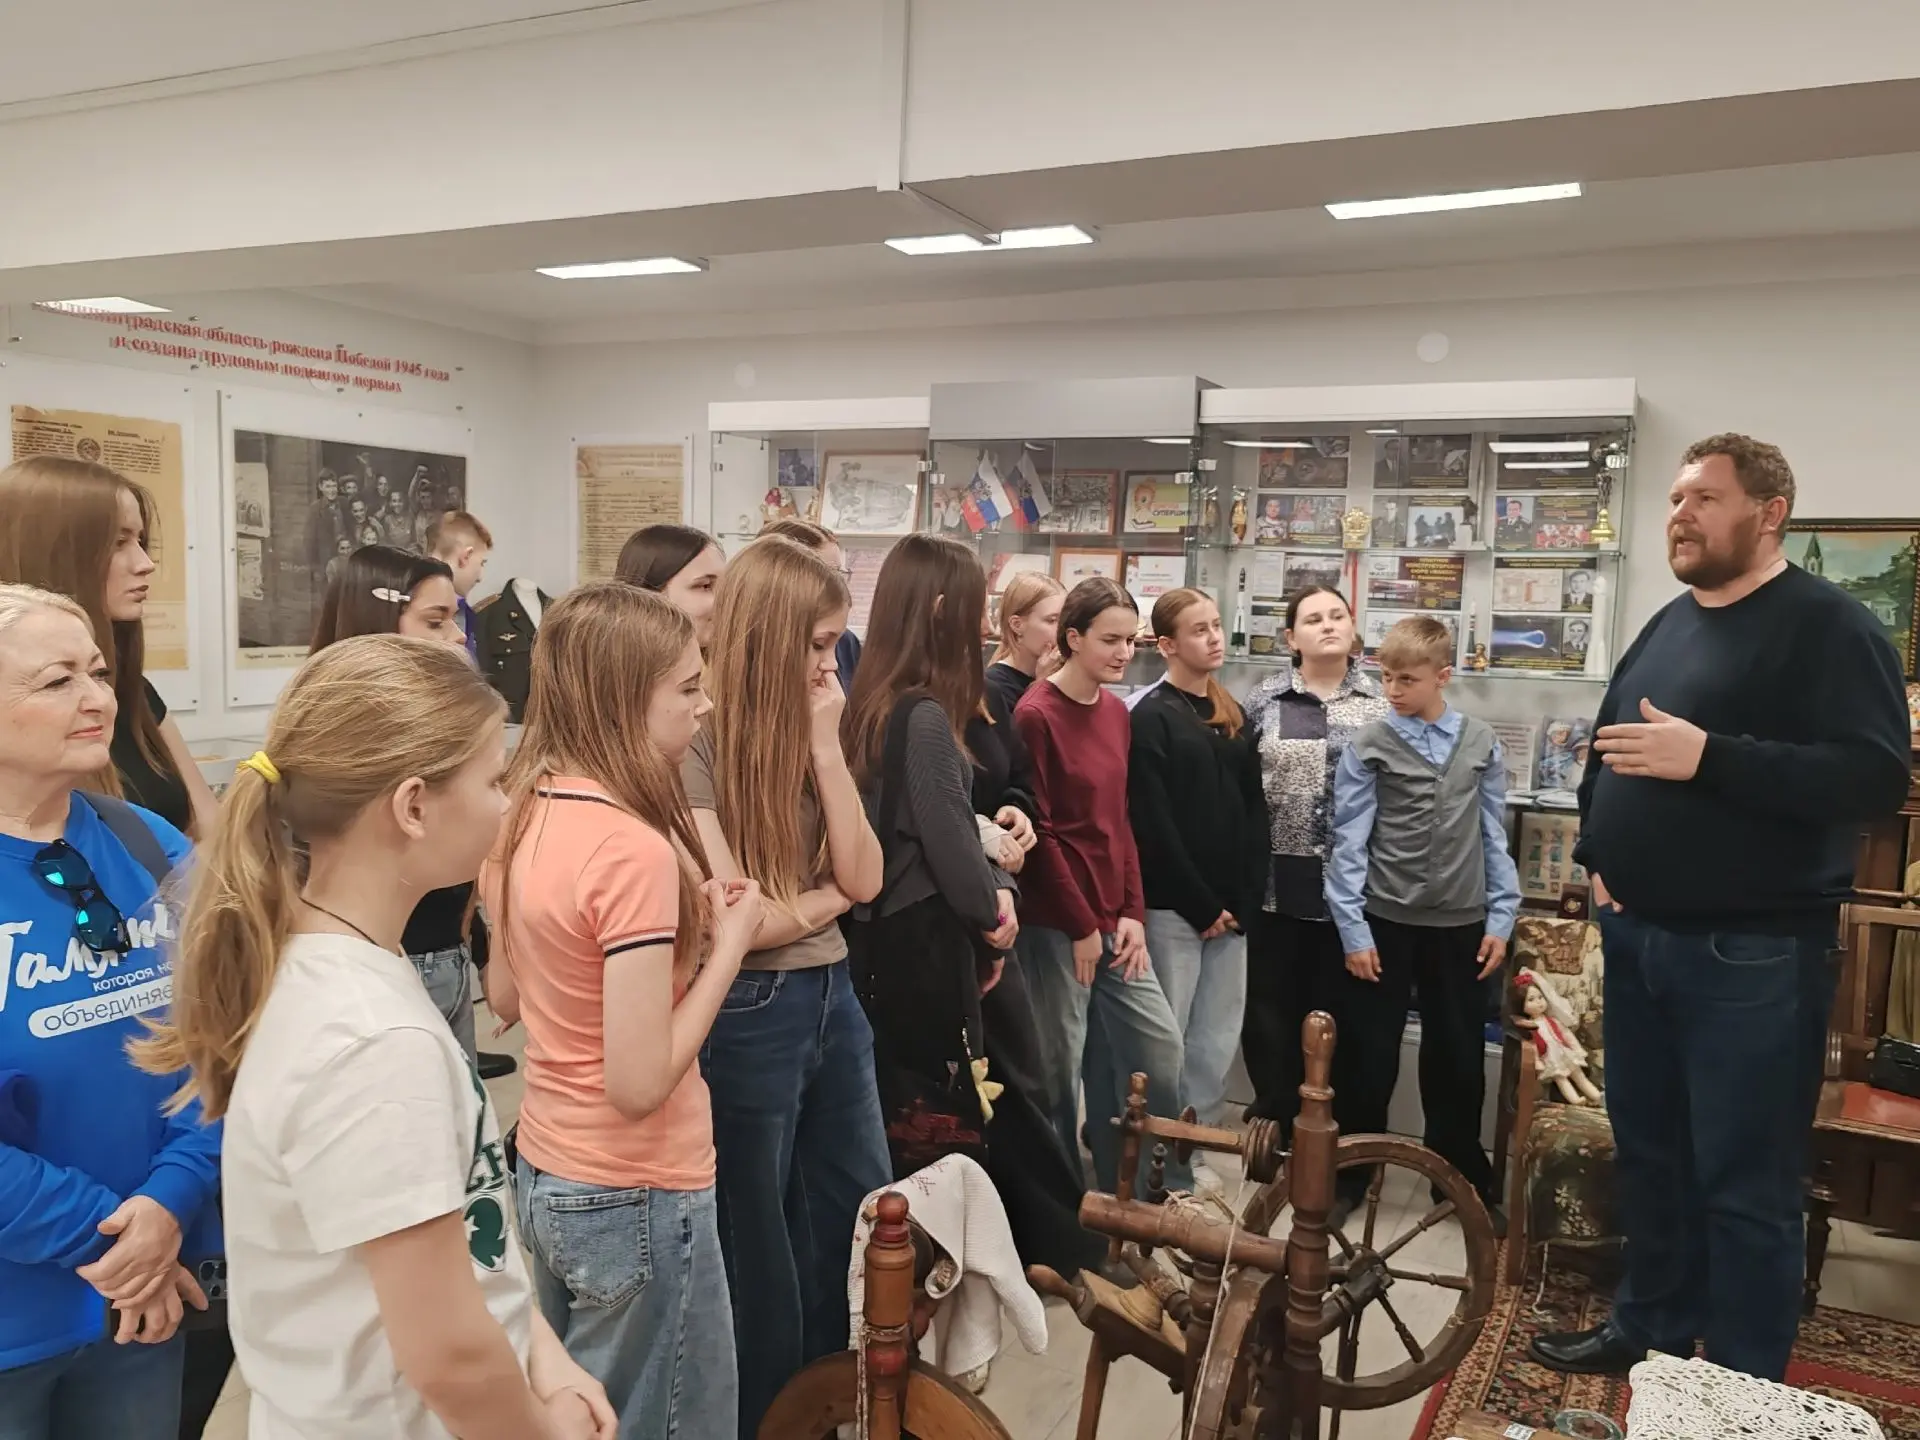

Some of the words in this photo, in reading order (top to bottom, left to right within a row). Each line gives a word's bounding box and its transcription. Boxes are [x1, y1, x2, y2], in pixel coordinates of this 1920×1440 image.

[131, 336, 197, 359] создана
[204, 348, 280, 373] трудовым
[281, 361, 350, 385] подвигом
[354, 374, 403, 393] первых
[204, 325, 268, 350] область
[269, 339, 333, 363] рождена
[334, 347, 392, 373] Победой
[395, 358, 423, 377] 1945
[423, 366, 450, 381] года
[93, 967, 155, 992] которая
[157, 960, 174, 977] на
[44, 983, 173, 1031] объединяе
